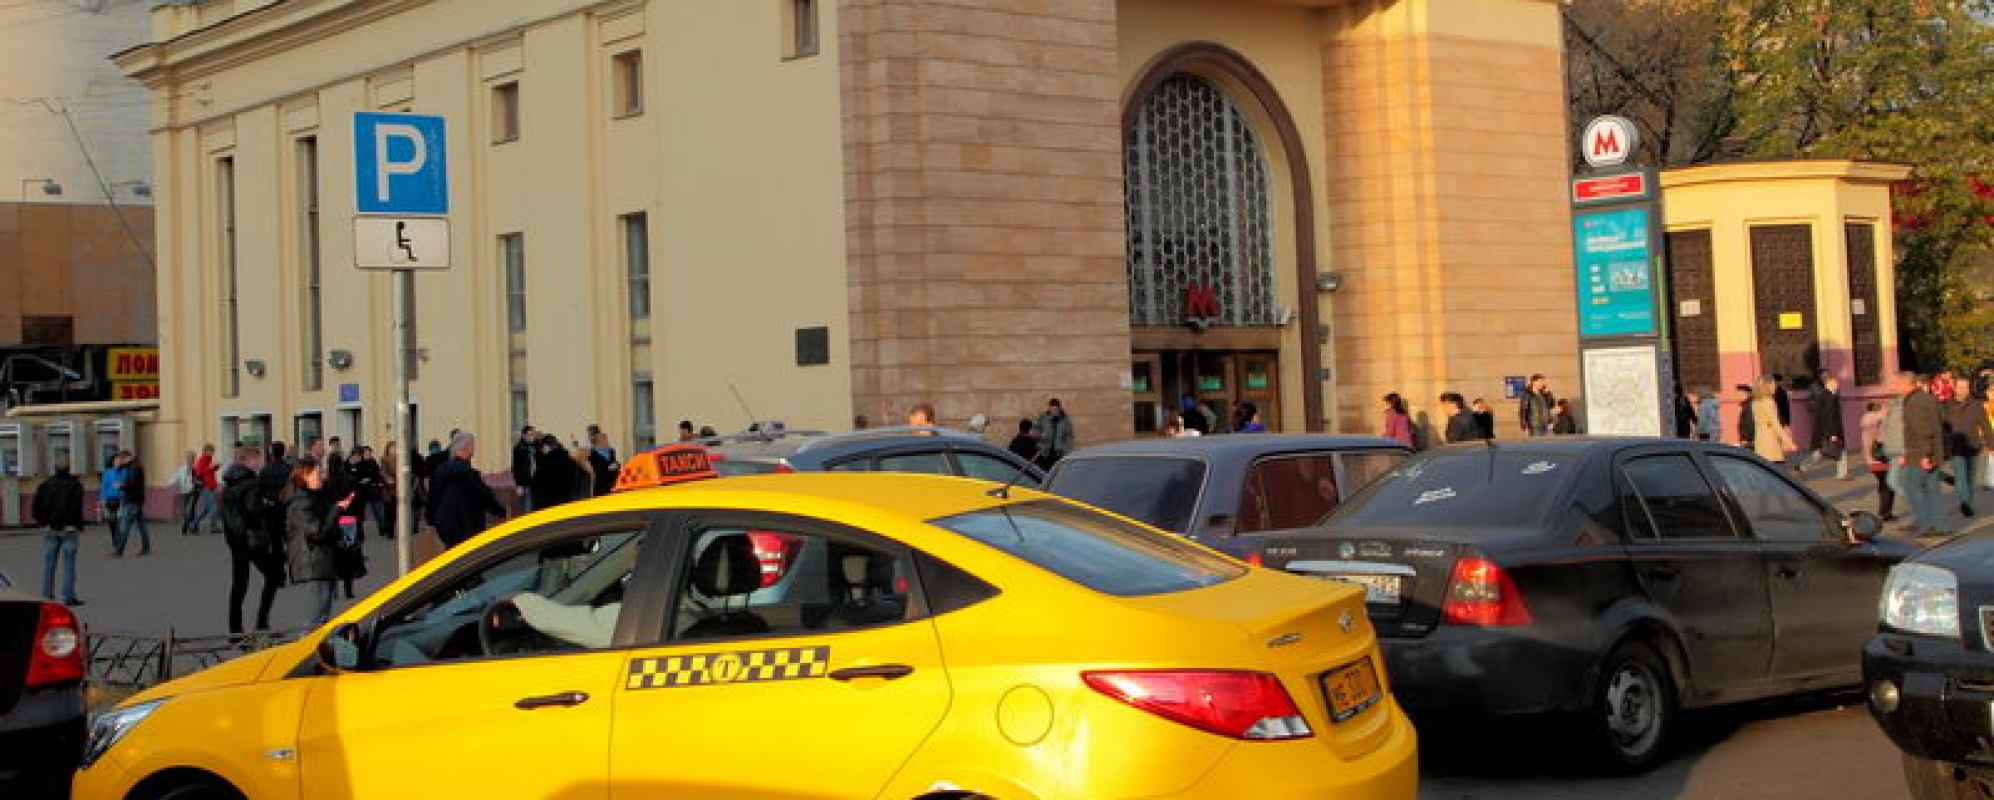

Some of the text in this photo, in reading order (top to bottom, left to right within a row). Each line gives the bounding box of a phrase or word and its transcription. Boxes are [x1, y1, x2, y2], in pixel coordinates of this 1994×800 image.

[1593, 129, 1620, 156] М
[375, 122, 427, 203] P
[1185, 281, 1221, 317] М
[657, 450, 711, 477] ТАКСИ
